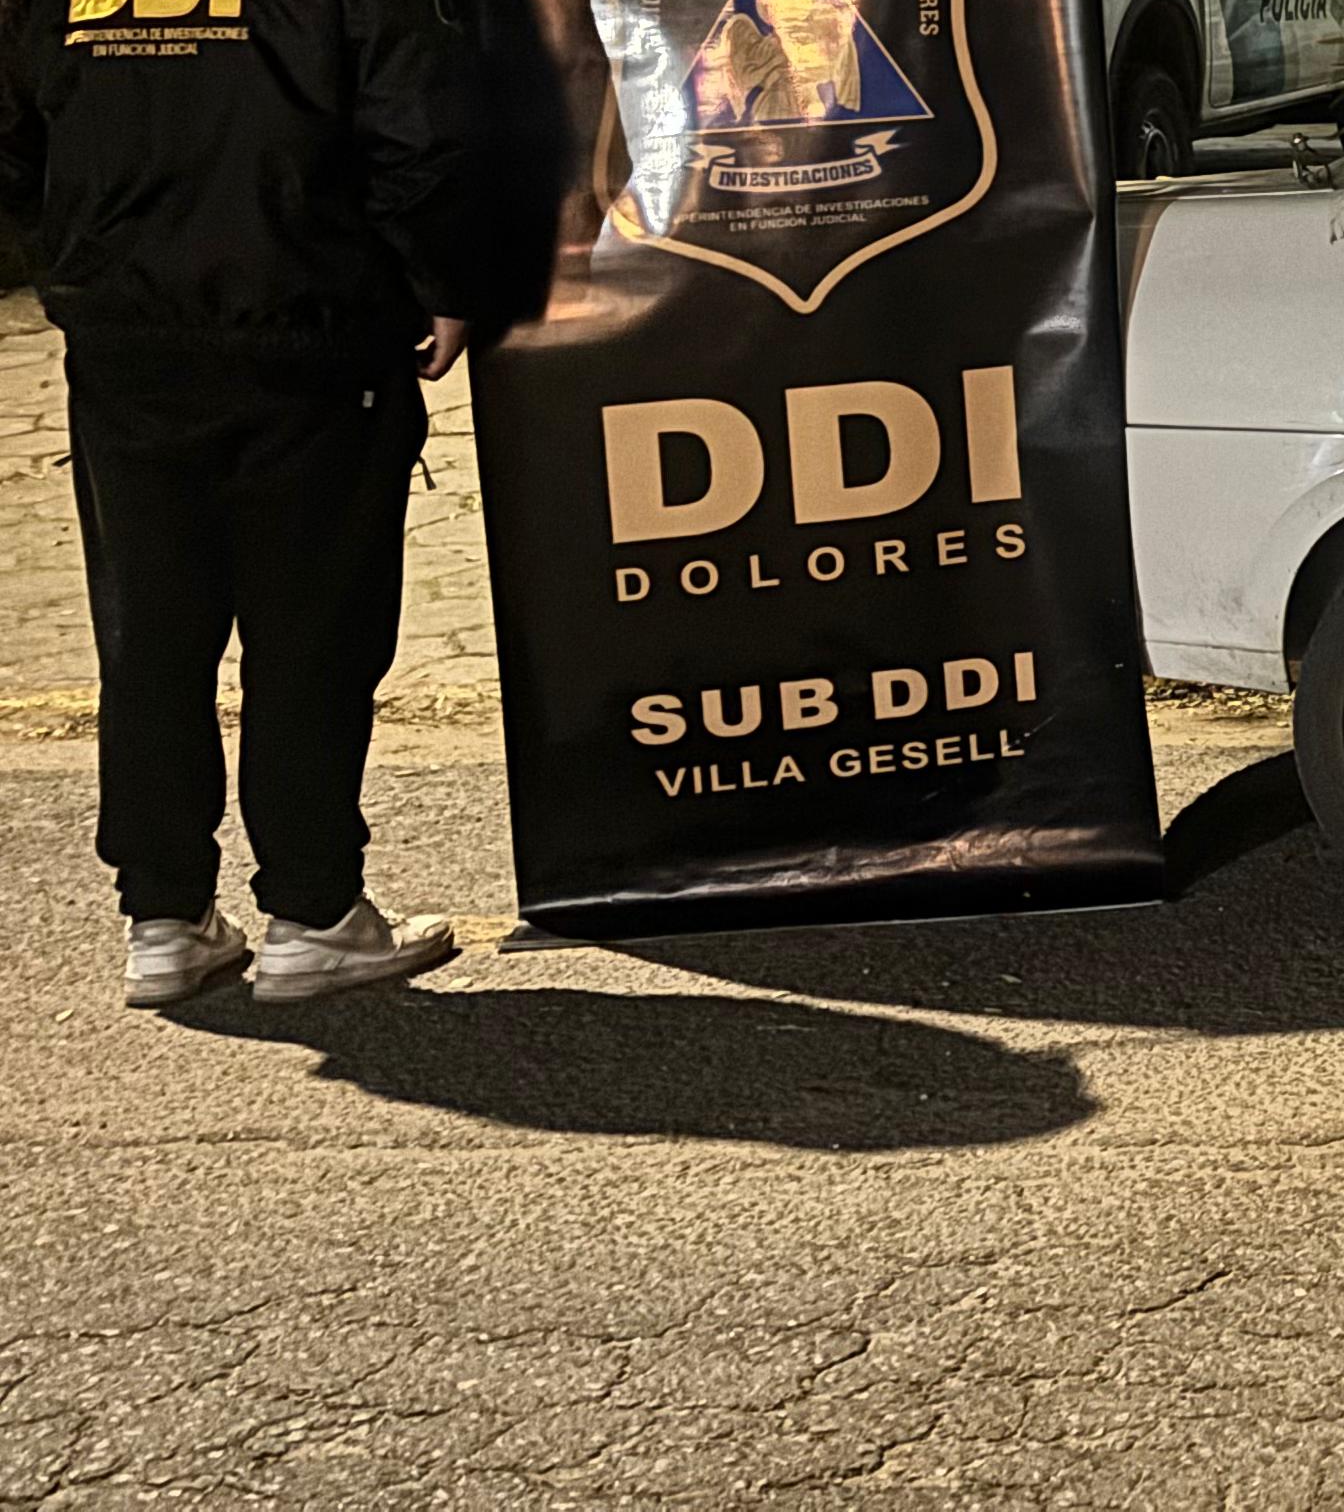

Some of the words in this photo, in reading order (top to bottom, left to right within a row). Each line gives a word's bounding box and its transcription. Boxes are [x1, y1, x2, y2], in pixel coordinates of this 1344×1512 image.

[719, 160, 874, 188] INVESTIGACIONES
[672, 205, 792, 224] PERINTENDENCIA
[795, 203, 810, 215] DE
[815, 195, 930, 212] INVESTIGACIONES
[729, 222, 747, 232] EN
[810, 213, 867, 226] JUDICIAL
[602, 365, 1022, 544] DDI
[615, 524, 1026, 602] DOLORES
[631, 678, 839, 745] SUB
[872, 651, 1036, 720] DDI
[656, 755, 805, 796] VILLA
[829, 729, 1025, 777] GESELL
